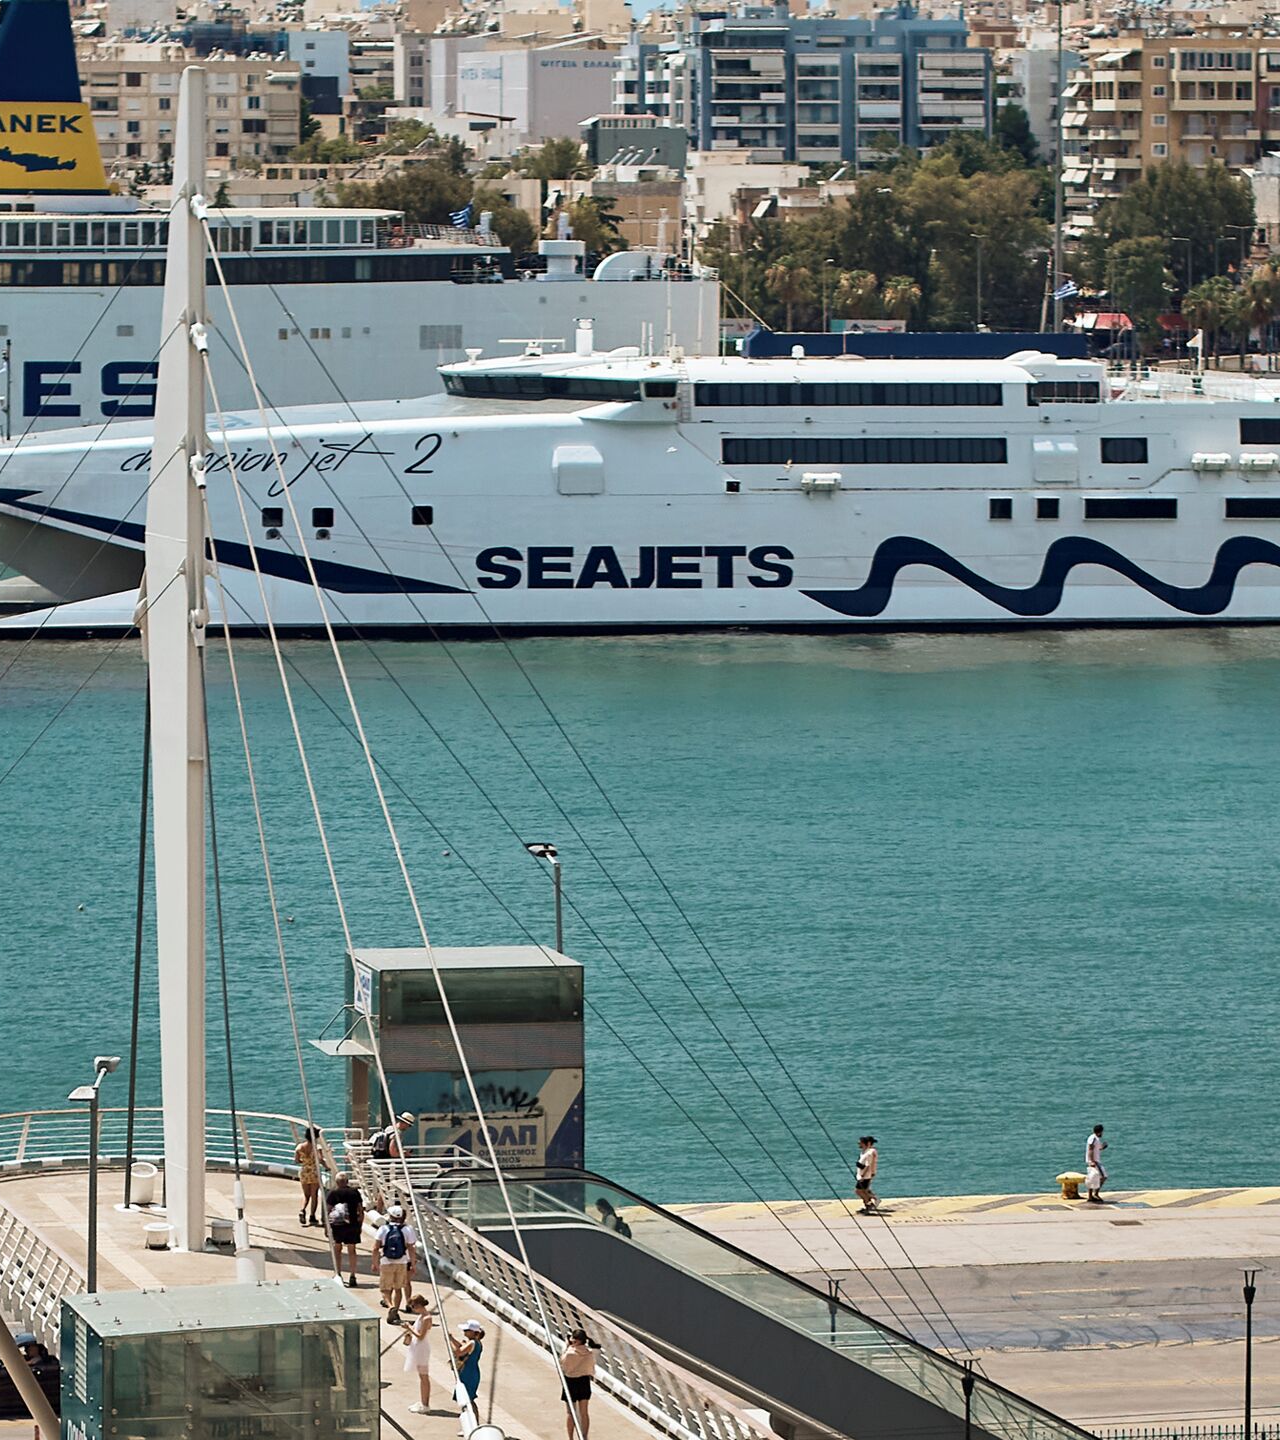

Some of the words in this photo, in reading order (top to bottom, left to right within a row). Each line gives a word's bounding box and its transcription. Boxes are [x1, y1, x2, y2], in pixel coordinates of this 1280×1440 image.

[268, 432, 396, 497] jet
[404, 432, 442, 474] 2
[476, 545, 794, 589] SEAJETS
[476, 1124, 537, 1146] ΟΛΠ
